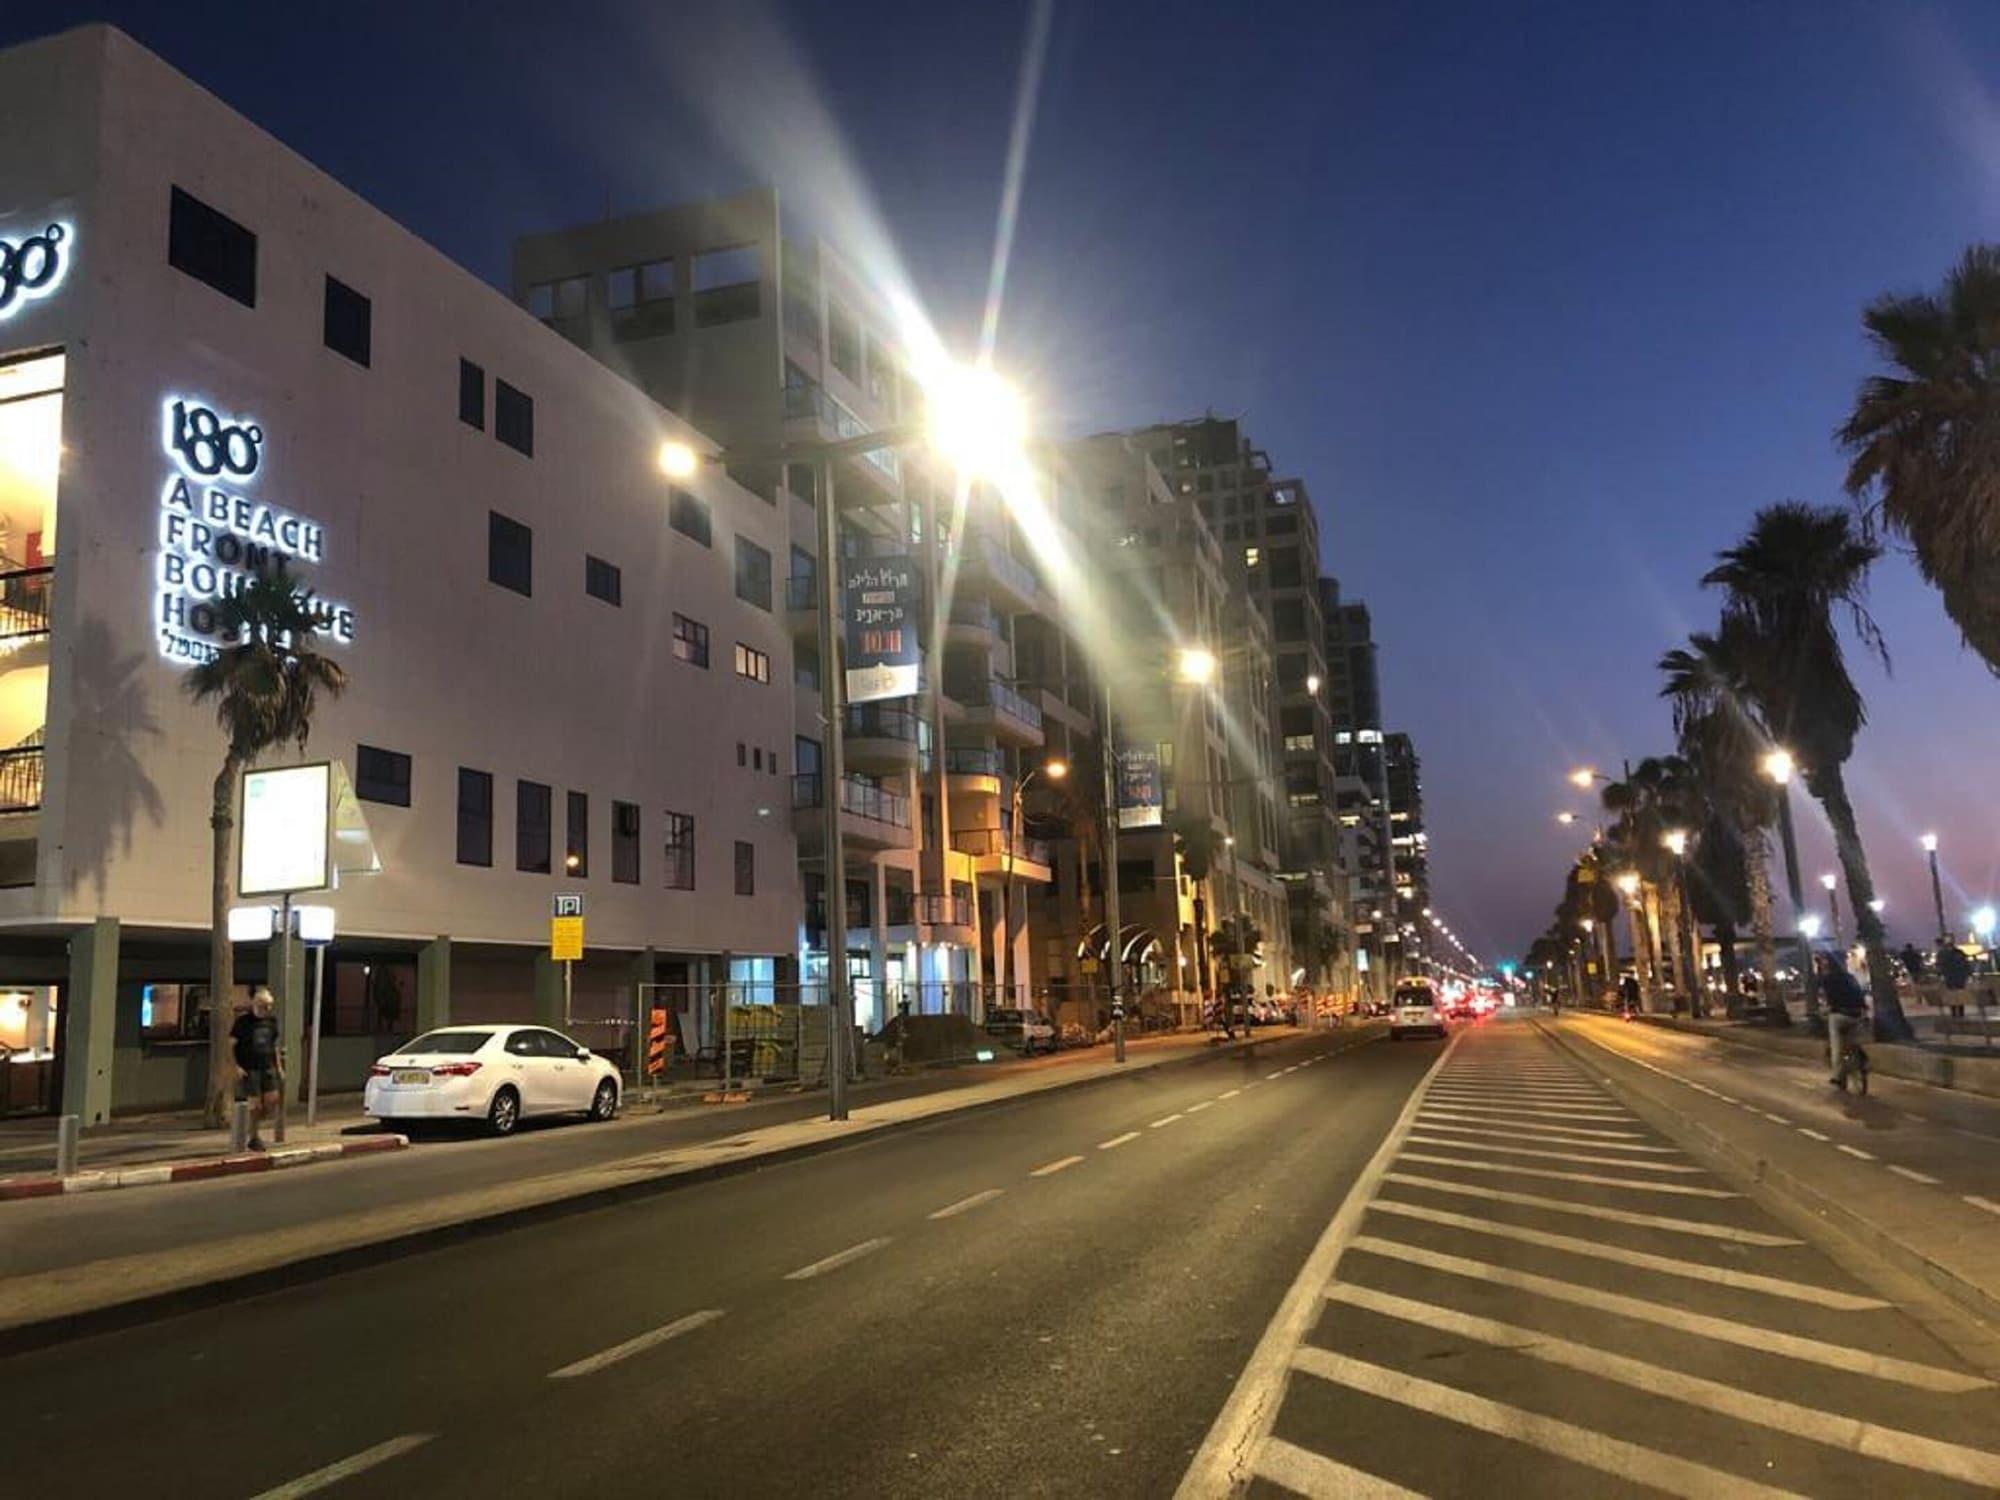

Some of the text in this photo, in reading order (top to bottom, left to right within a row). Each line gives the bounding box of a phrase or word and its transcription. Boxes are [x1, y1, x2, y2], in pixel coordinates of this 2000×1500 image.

[167, 514, 291, 578] FRONT
[168, 477, 323, 559] A BEACH
[164, 553, 354, 640] BOUUE
